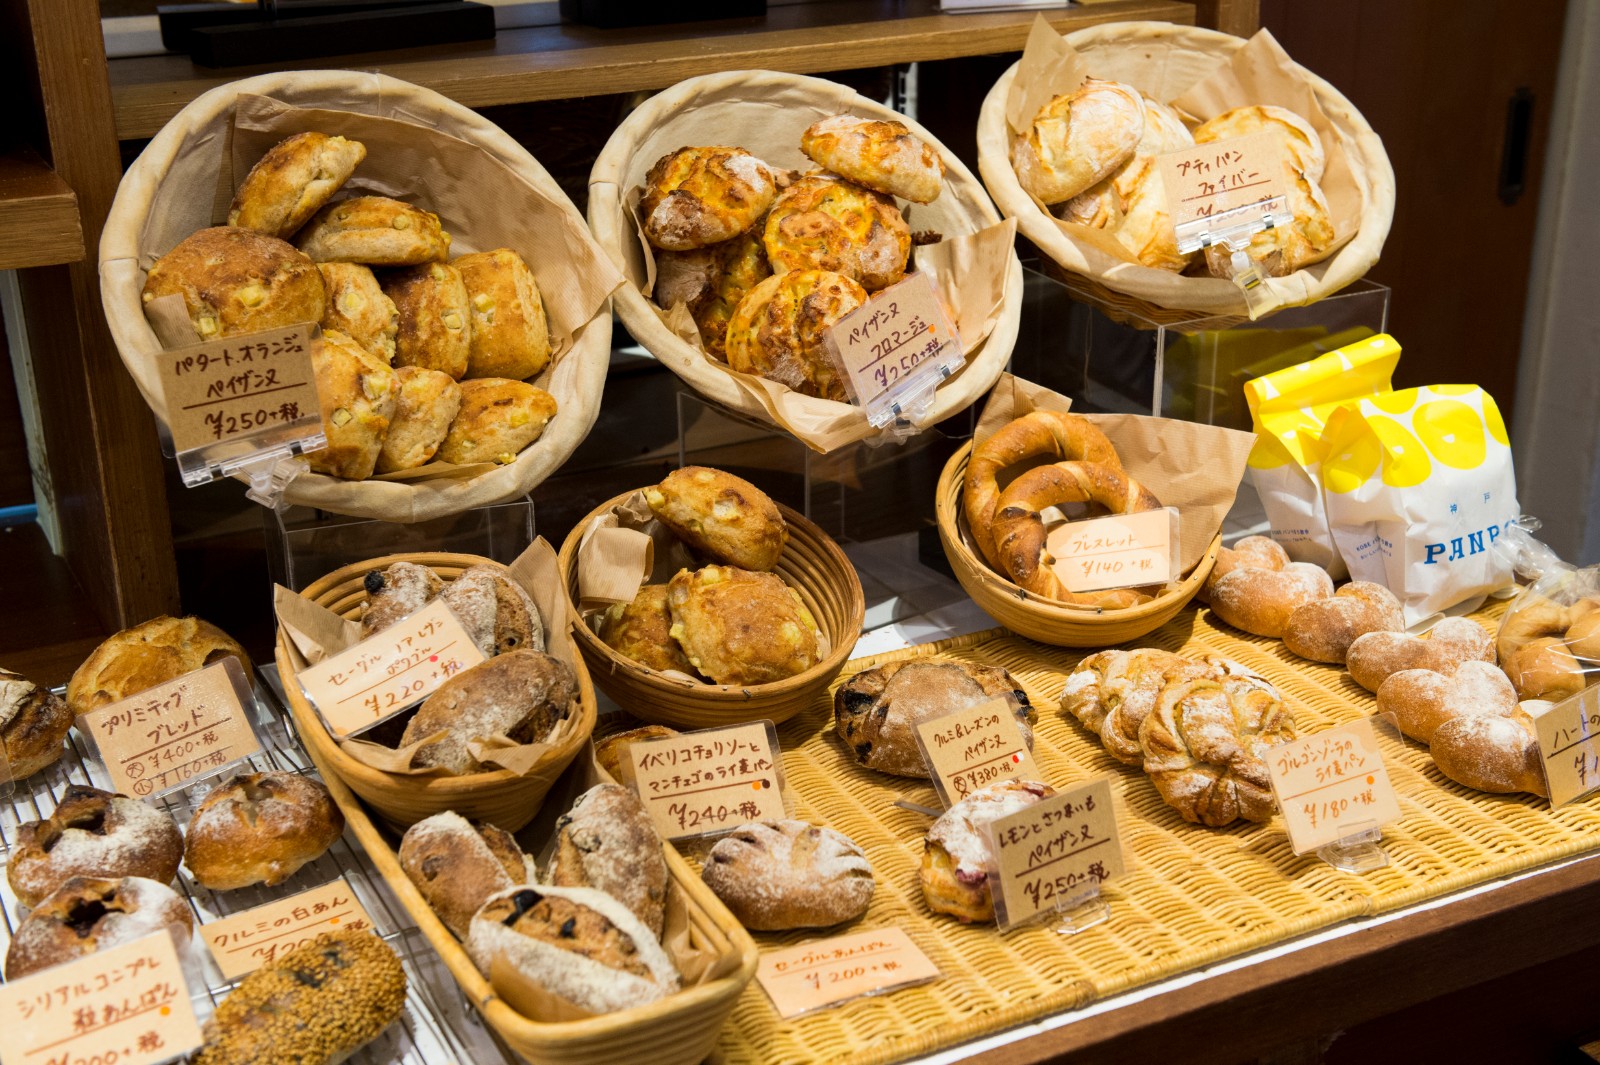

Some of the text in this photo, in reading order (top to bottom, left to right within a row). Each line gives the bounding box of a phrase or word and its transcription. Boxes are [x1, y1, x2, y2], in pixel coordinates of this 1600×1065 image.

[1176, 150, 1243, 177] プティパン
[1198, 168, 1259, 195] ファイバー
[848, 302, 900, 346] ペイザンヌ
[870, 315, 927, 361] フロマージュ
[207, 368, 280, 398] ペイザンヌ
[1073, 534, 1137, 554] ブレスレット
[1423, 519, 1517, 565] PANP
[386, 646, 432, 675] ポワブル
[101, 684, 187, 736] プリミティブ
[147, 704, 205, 744] ブレッド
[638, 738, 761, 771] イベリコチョリソーと
[964, 734, 1007, 761] ペイザンヌ
[1277, 739, 1353, 777] ゴルゴンゾーラの
[649, 758, 773, 793] マンチェゴのライ麦パン
[1315, 753, 1365, 783] ライ麦パン
[998, 795, 1096, 849] レモンとさつまいも
[1028, 824, 1094, 867] ペイザンヌ
[213, 897, 349, 948] クルミの白あん
[17, 956, 160, 1020] シリアルコンプレ
